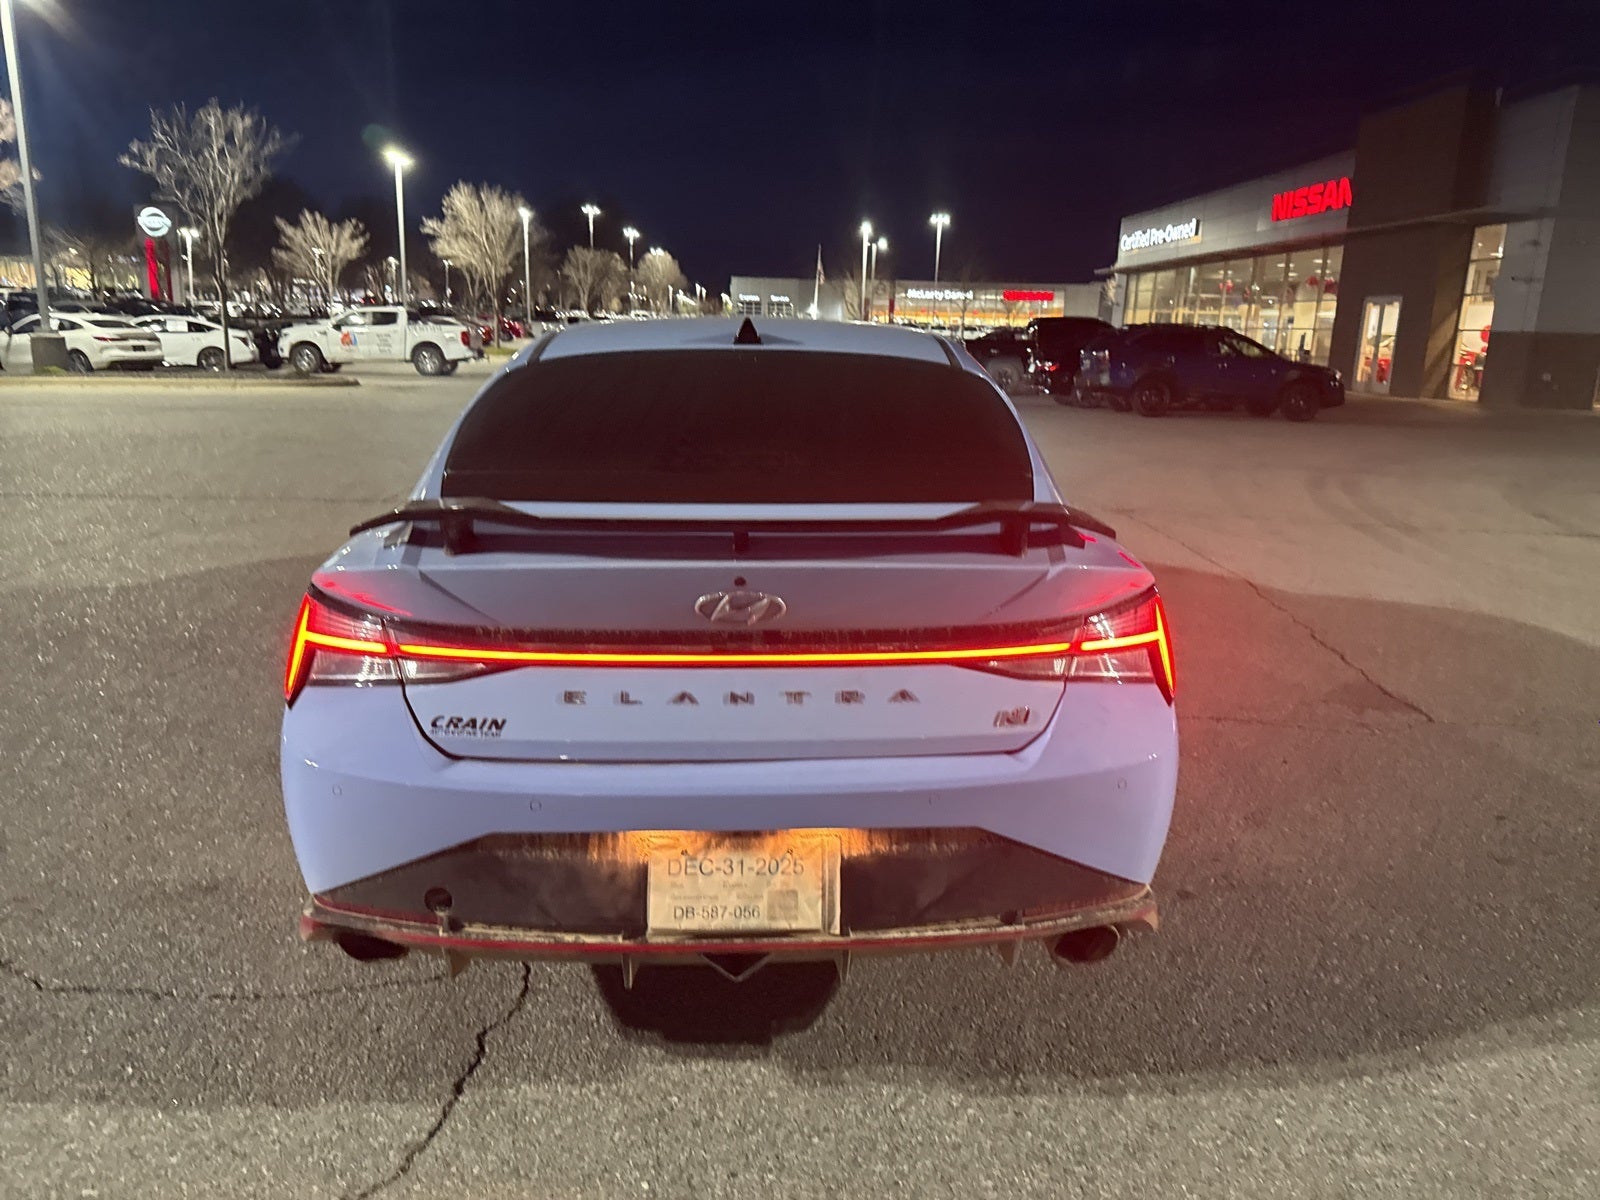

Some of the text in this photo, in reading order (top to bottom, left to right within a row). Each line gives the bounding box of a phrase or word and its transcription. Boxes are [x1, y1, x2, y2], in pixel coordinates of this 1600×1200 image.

[1272, 177, 1352, 221] NISSAN
[1120, 217, 1197, 251] Certified Pre-Owned
[561, 689, 921, 706] ELANTRA
[430, 715, 507, 730] CRAIN
[667, 857, 805, 877] DEC-31-2025
[673, 905, 761, 920] DB-587-056
